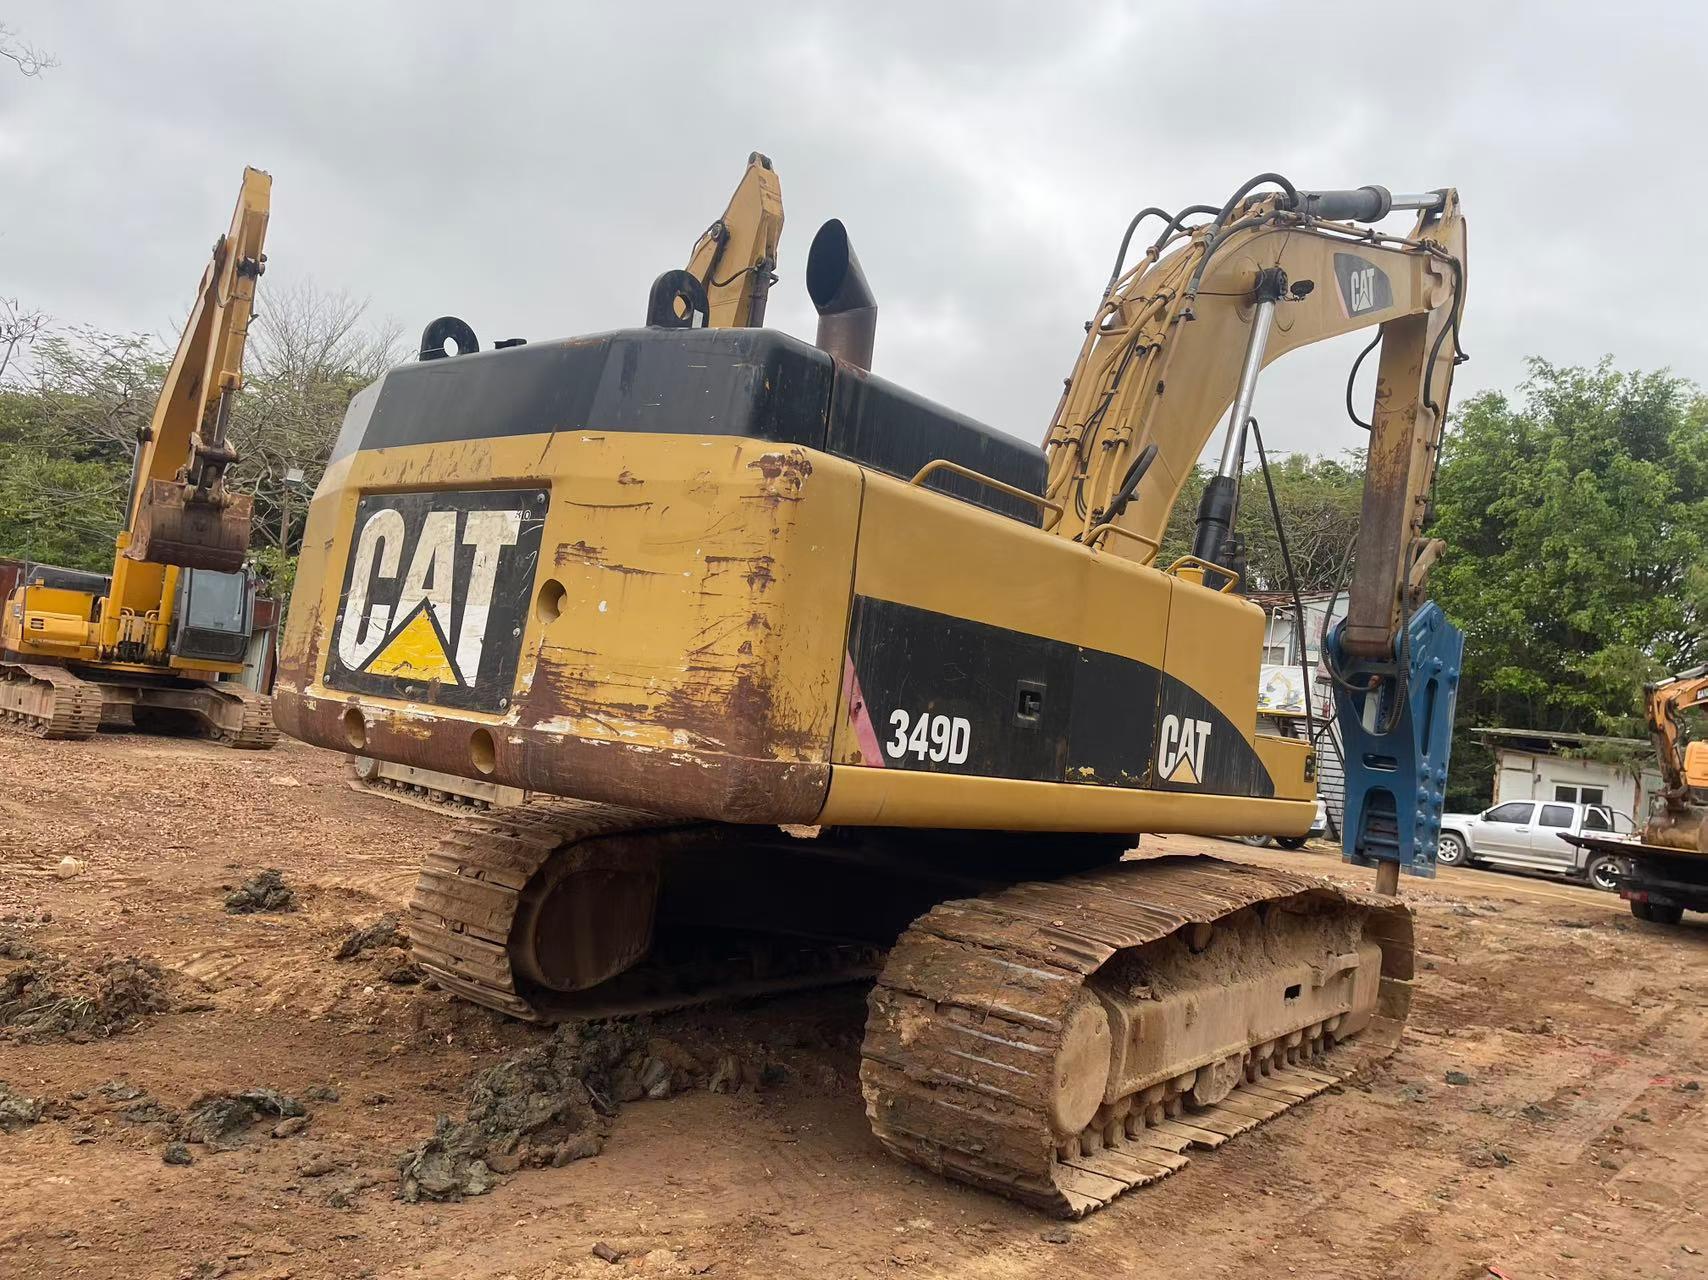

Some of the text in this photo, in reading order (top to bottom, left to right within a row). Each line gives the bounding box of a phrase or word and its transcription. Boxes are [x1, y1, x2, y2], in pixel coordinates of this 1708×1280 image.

[1350, 268, 1375, 312] CAT
[338, 508, 522, 688] CAT
[886, 708, 971, 765] 349D
[1157, 714, 1212, 784] CAT
